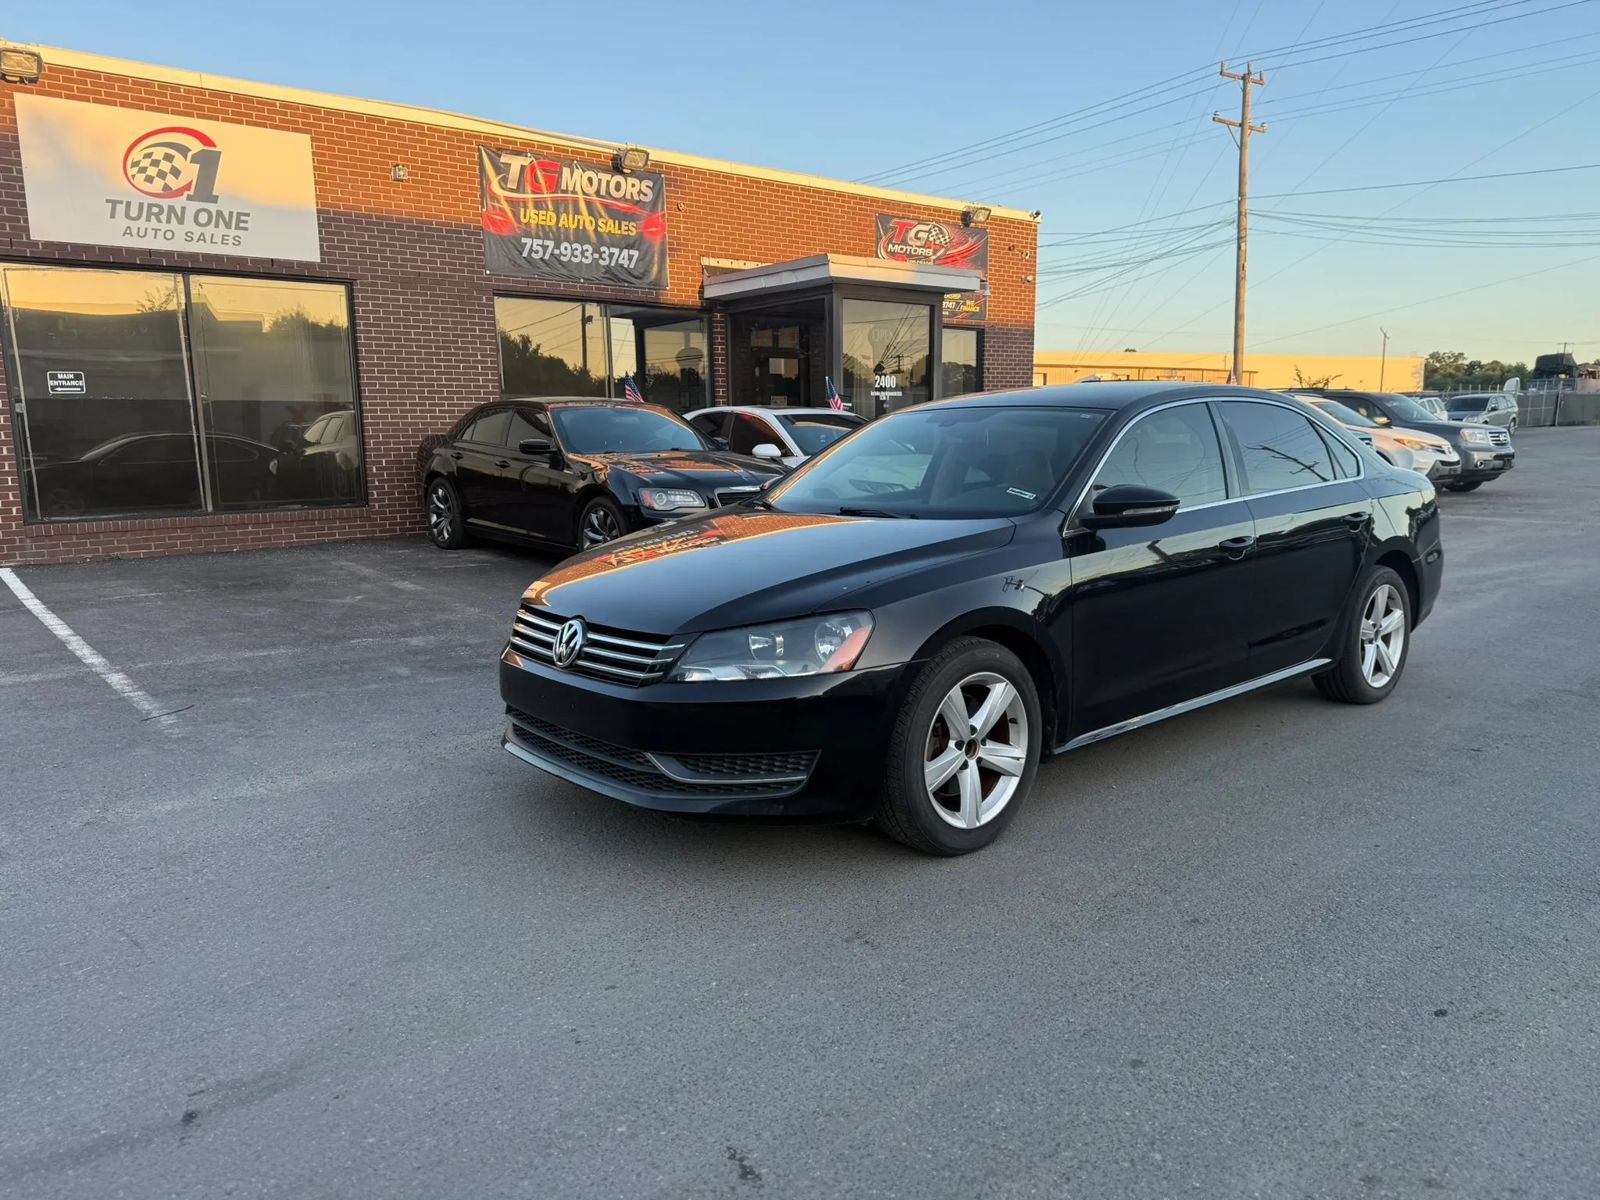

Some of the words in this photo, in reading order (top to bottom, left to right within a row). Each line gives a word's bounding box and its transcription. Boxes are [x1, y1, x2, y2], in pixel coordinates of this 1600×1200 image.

[561, 167, 654, 202] MOTORS
[105, 198, 186, 225] TURN
[193, 207, 251, 232] ONE
[519, 208, 557, 226] USED
[558, 213, 596, 232] AUTO
[597, 216, 637, 236] SALES
[121, 225, 175, 241] AUTO
[184, 230, 242, 247] SALES
[887, 243, 933, 256] MOTORS
[520, 237, 639, 269] 757-933-3747
[875, 375, 896, 388] 2400
